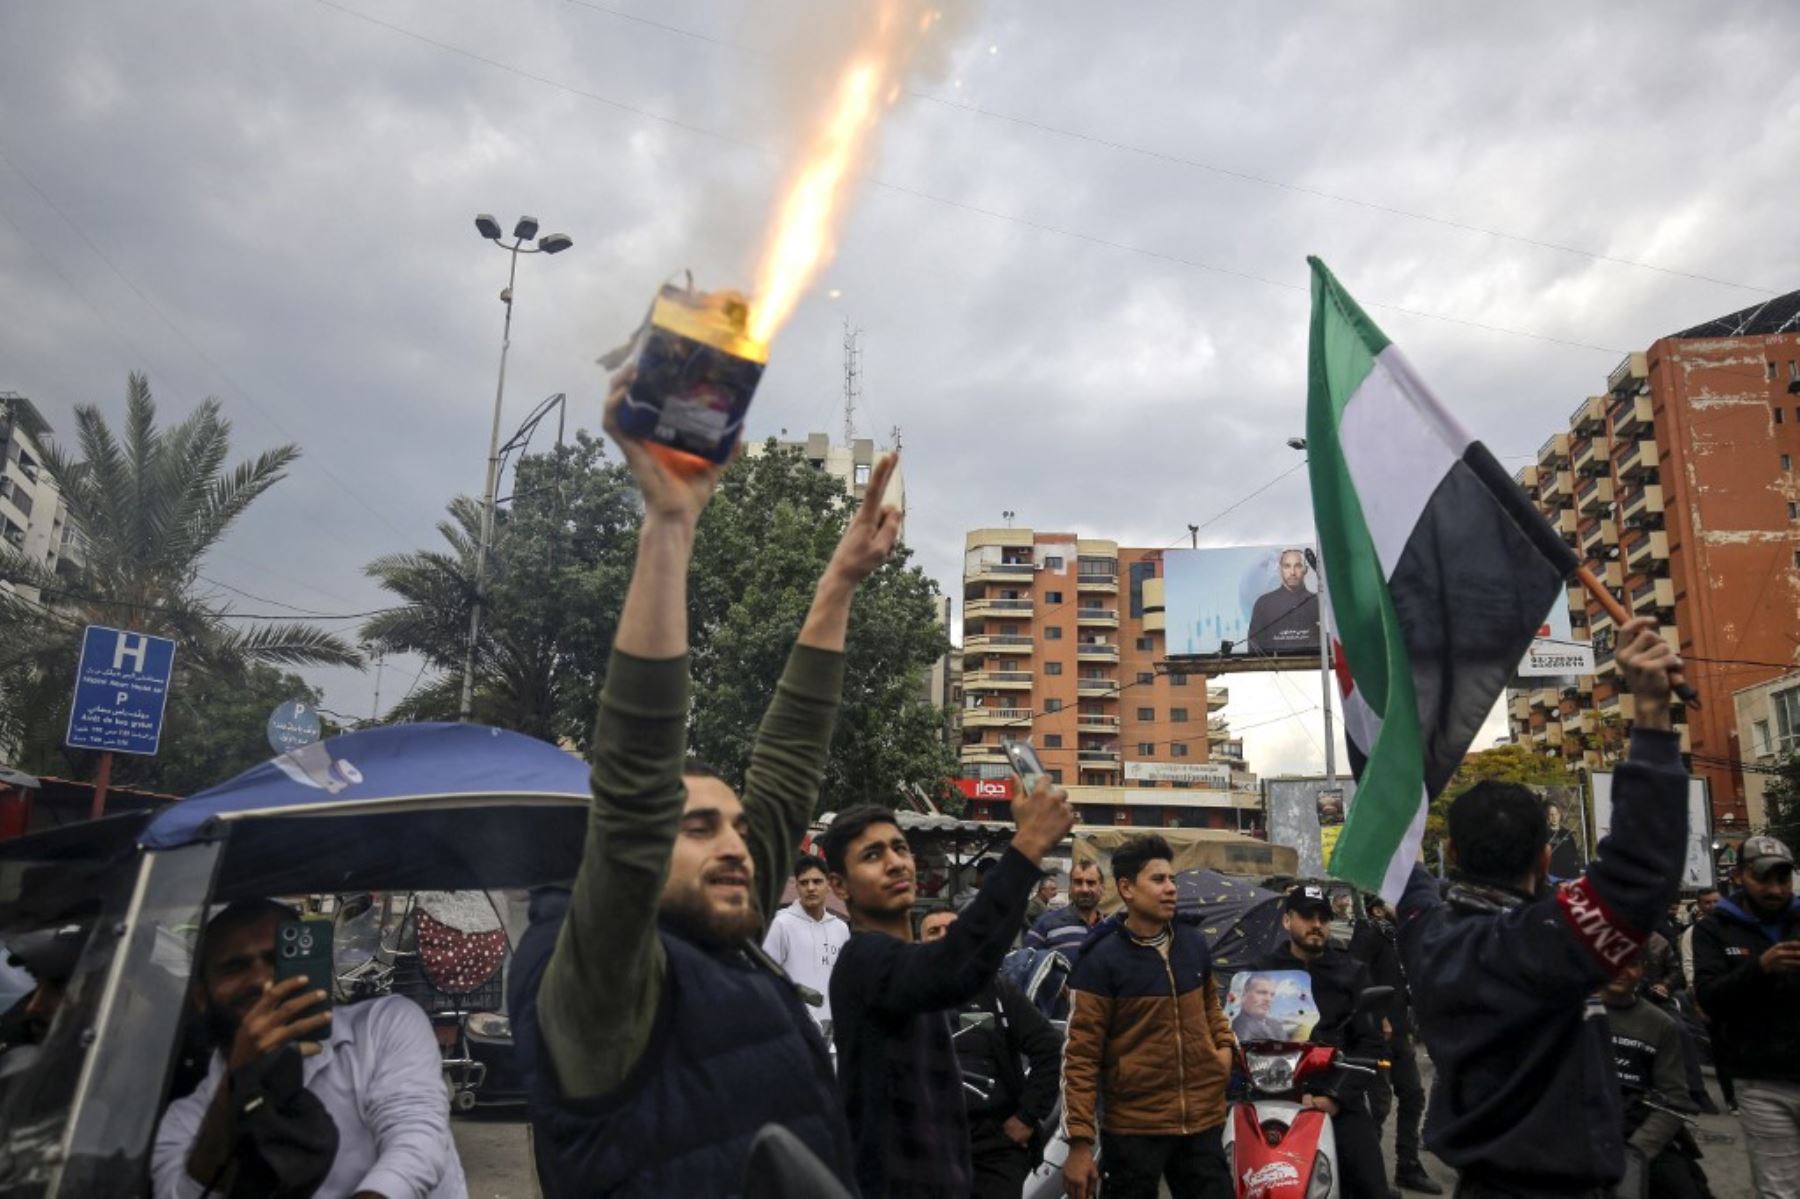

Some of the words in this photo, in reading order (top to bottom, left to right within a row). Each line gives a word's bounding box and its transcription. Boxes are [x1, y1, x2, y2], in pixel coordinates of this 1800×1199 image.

[113, 633, 148, 672] H
[116, 692, 128, 705] P
[294, 703, 305, 719] P
